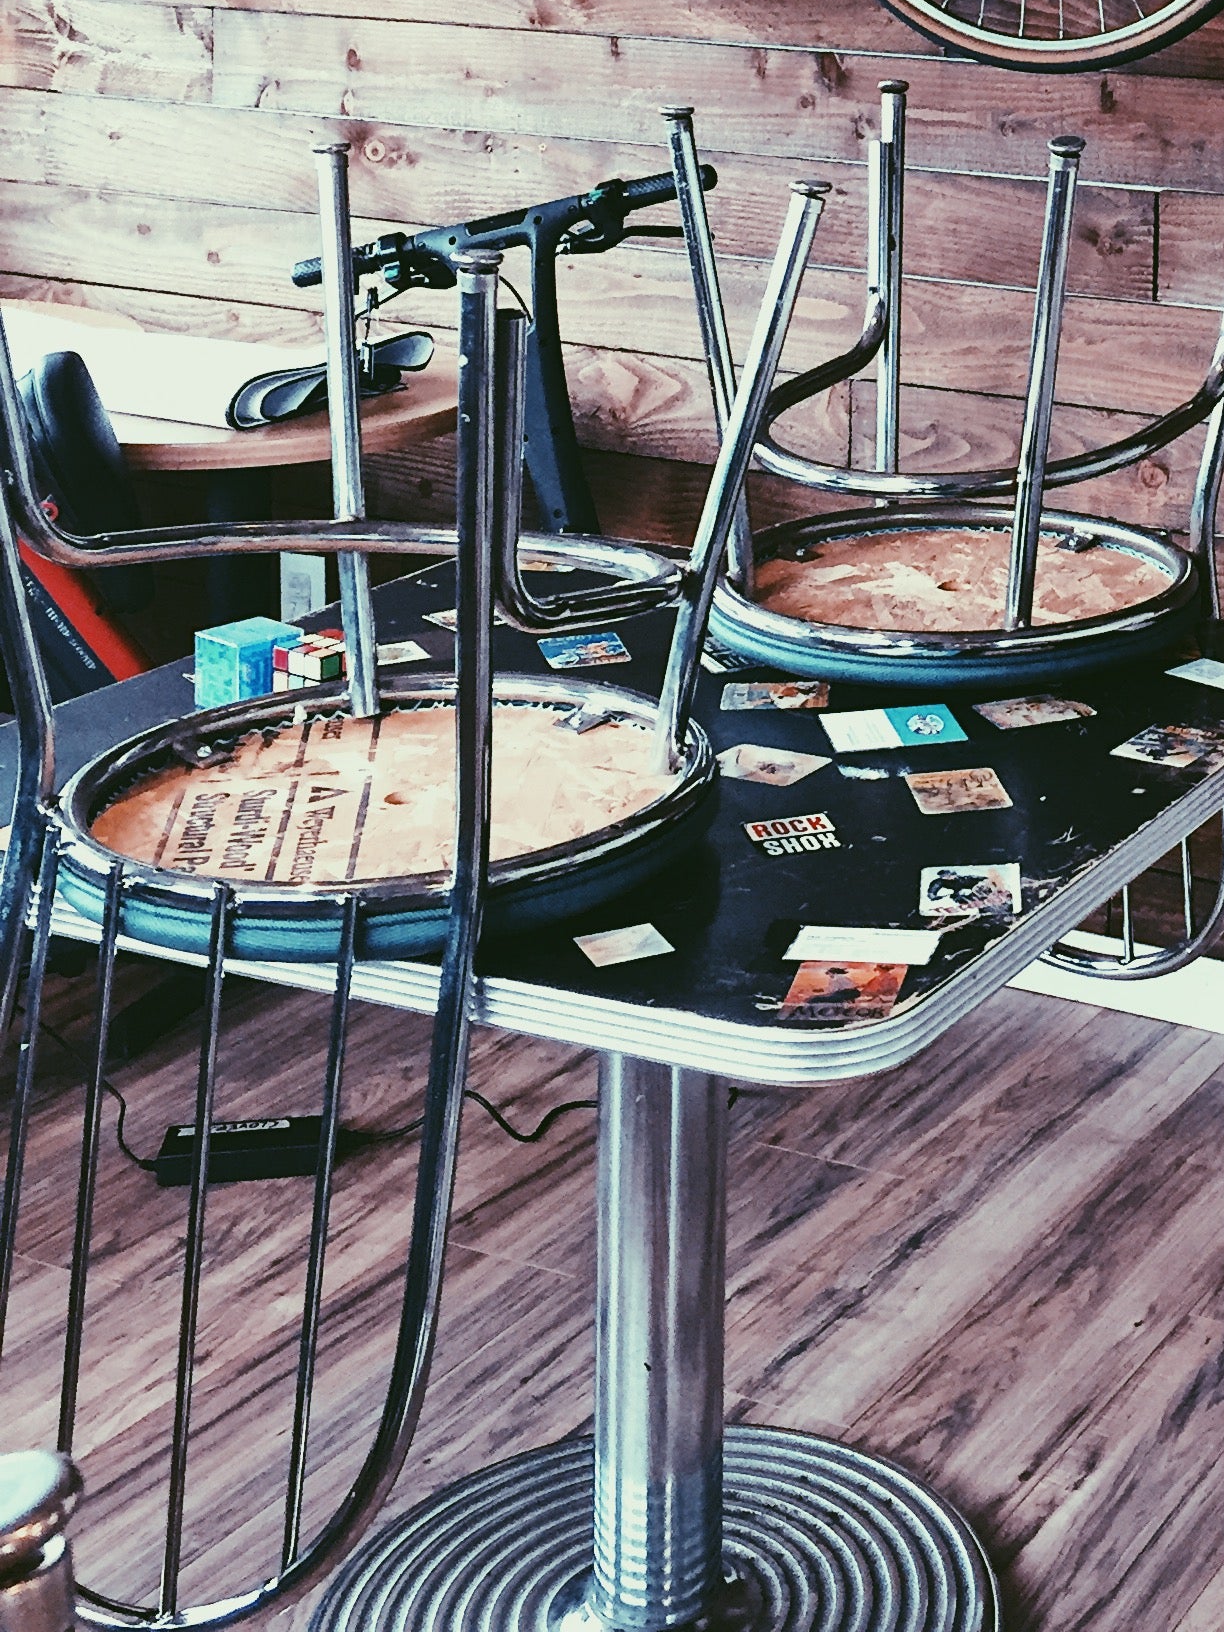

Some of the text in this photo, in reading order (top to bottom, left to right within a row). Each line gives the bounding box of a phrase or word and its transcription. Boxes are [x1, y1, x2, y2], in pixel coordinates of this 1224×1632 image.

[178, 792, 231, 854] Structural
[751, 816, 828, 838] ROCK
[763, 832, 842, 856] SHOX
